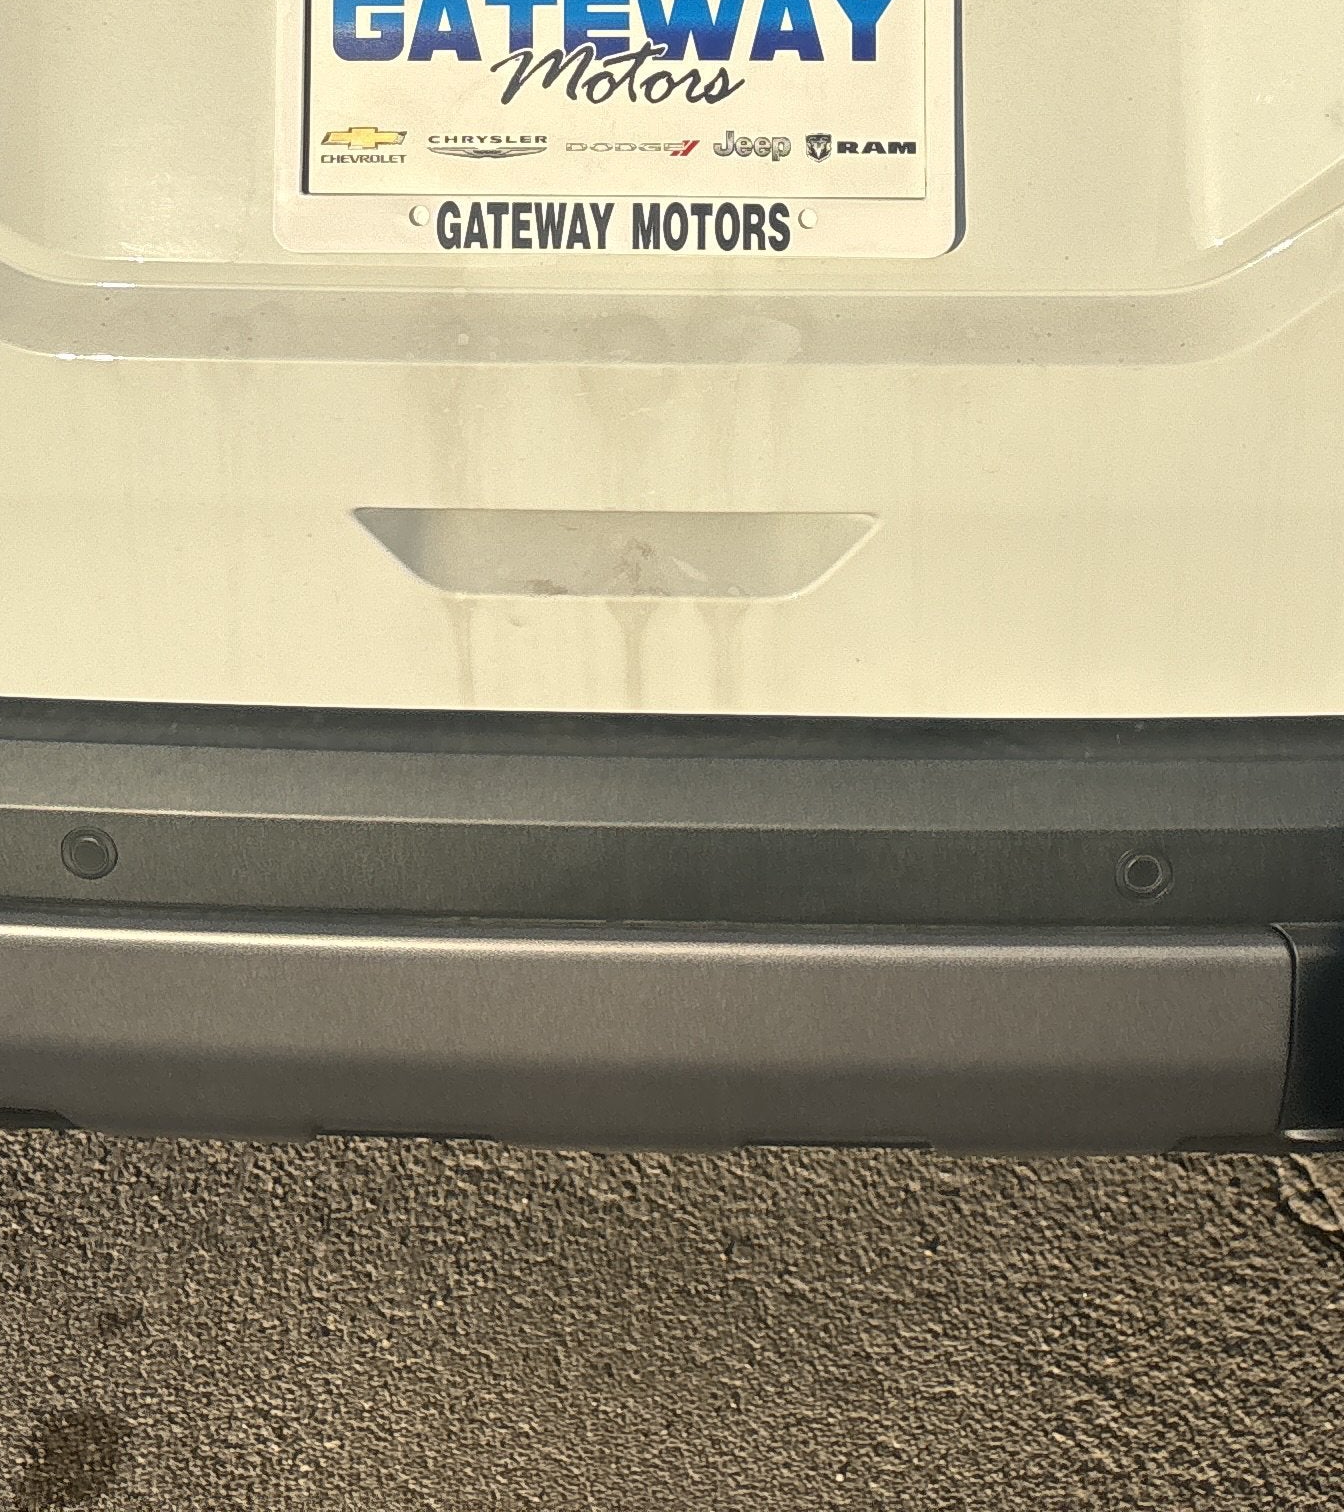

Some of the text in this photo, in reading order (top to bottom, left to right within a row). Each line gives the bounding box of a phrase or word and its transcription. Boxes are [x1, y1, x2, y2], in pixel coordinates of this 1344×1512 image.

[490, 41, 745, 105] Motors
[428, 135, 548, 144] CHRYSLER
[713, 130, 792, 162] Jeep
[565, 141, 686, 153] DODGE
[837, 141, 917, 155] RAM
[321, 154, 406, 164] CHEVROLET
[436, 201, 791, 252] GATEWAY MOTORS
